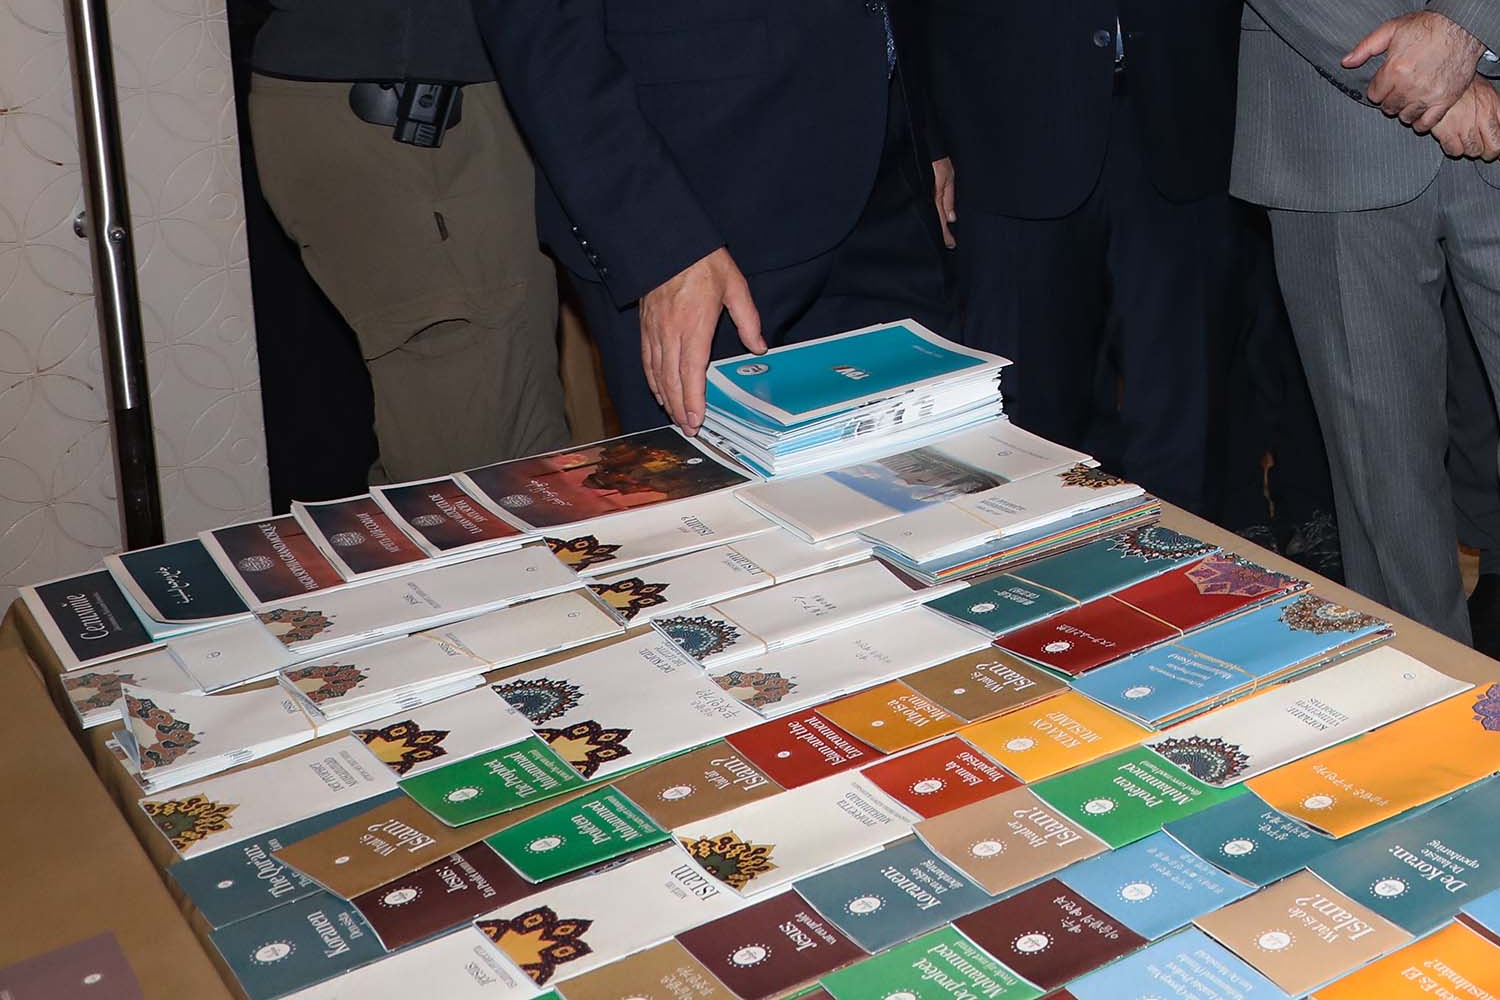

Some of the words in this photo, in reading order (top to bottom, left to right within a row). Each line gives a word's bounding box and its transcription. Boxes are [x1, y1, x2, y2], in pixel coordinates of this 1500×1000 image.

[965, 670, 984, 679] is
[974, 660, 1035, 690] Islam?
[974, 676, 1006, 691] What
[897, 709, 932, 726] Who
[899, 694, 949, 720] Muslim?
[782, 721, 807, 734] the
[1028, 717, 1053, 731] ON
[796, 733, 824, 747] and
[803, 717, 862, 757] Environment
[813, 745, 846, 764] Islam
[483, 760, 522, 785] Prophet
[504, 752, 560, 789] Muhammad
[710, 754, 767, 789] Islam?
[952, 768, 982, 785] Islam
[509, 783, 538, 797] The
[1109, 776, 1162, 807] Profeten
[1119, 764, 1190, 803] Muhammed
[569, 815, 610, 843] Profeten
[583, 801, 641, 840] Muhammed
[1006, 819, 1023, 830] er
[1012, 806, 1080, 845] Islam?
[357, 834, 375, 844] is
[367, 818, 431, 851] Islam?
[1013, 827, 1047, 846] Hvad
[368, 840, 398, 855] What
[1388, 845, 1443, 879] Koran:
[263, 874, 295, 896] The
[434, 866, 468, 892] Jesus:
[880, 867, 940, 908] Koranen:
[1434, 874, 1468, 891] De
[1282, 906, 1307, 919] de
[1294, 892, 1373, 939] Islam?
[1297, 915, 1316, 926] is
[306, 911, 348, 955] Koranen
[778, 921, 817, 951] Jesus:
[1308, 923, 1341, 942] Wat
[928, 944, 1004, 996] Mohammed
